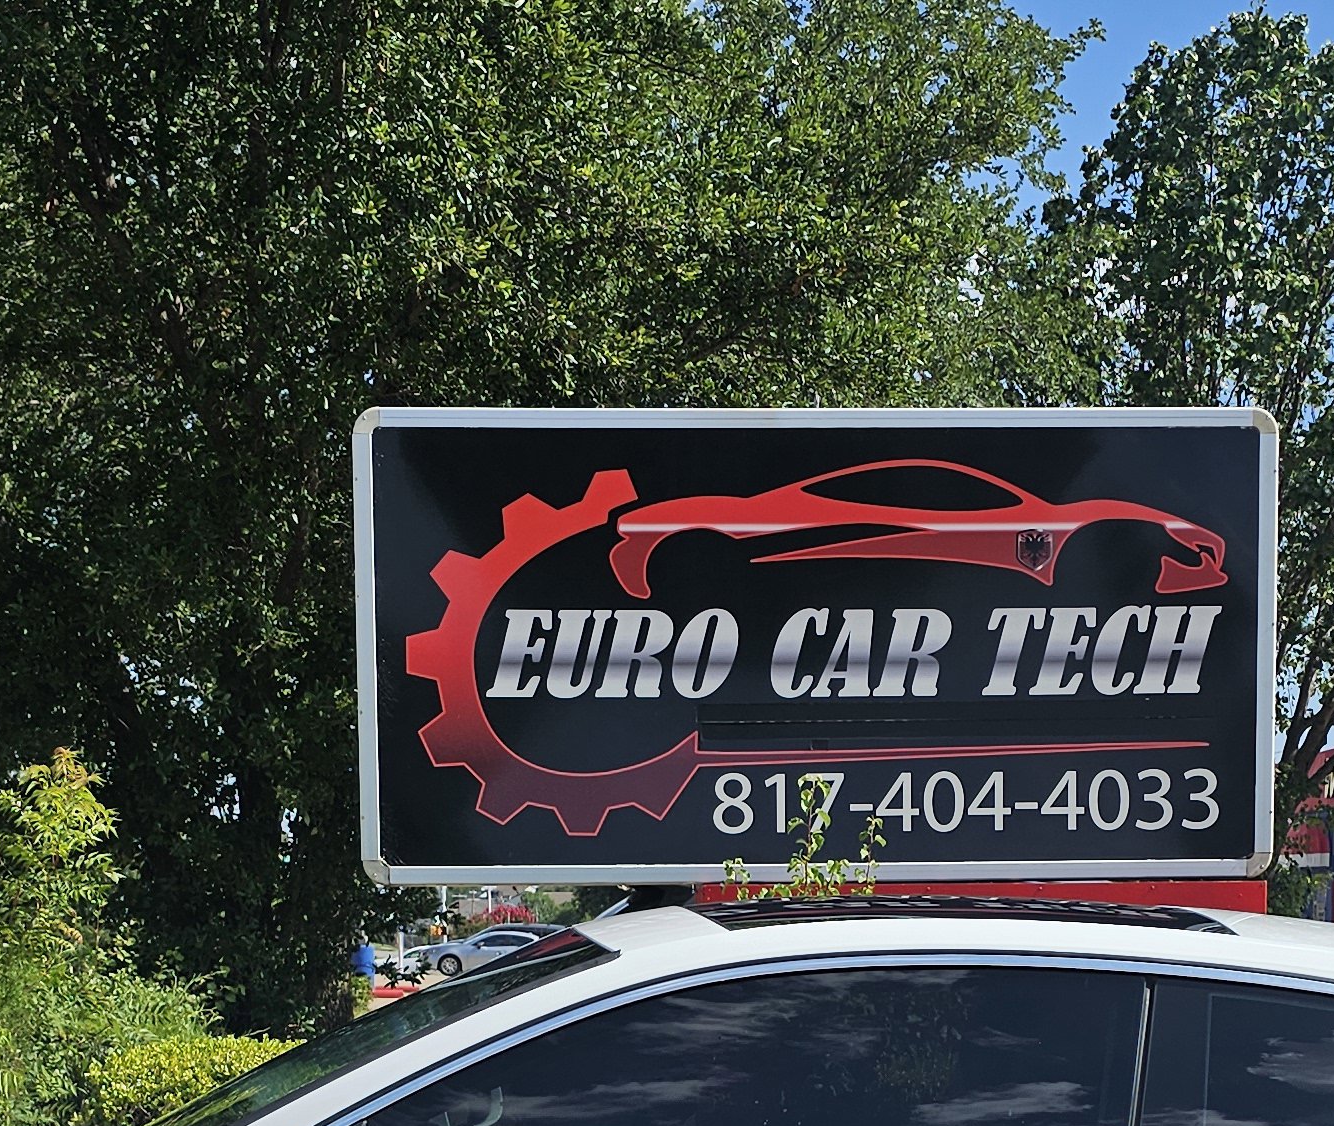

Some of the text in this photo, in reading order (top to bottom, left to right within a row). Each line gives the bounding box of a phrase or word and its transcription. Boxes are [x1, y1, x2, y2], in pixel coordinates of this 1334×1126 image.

[485, 604, 1223, 699] EURO CAR TECH
[712, 768, 1220, 835] 817-404-4033
